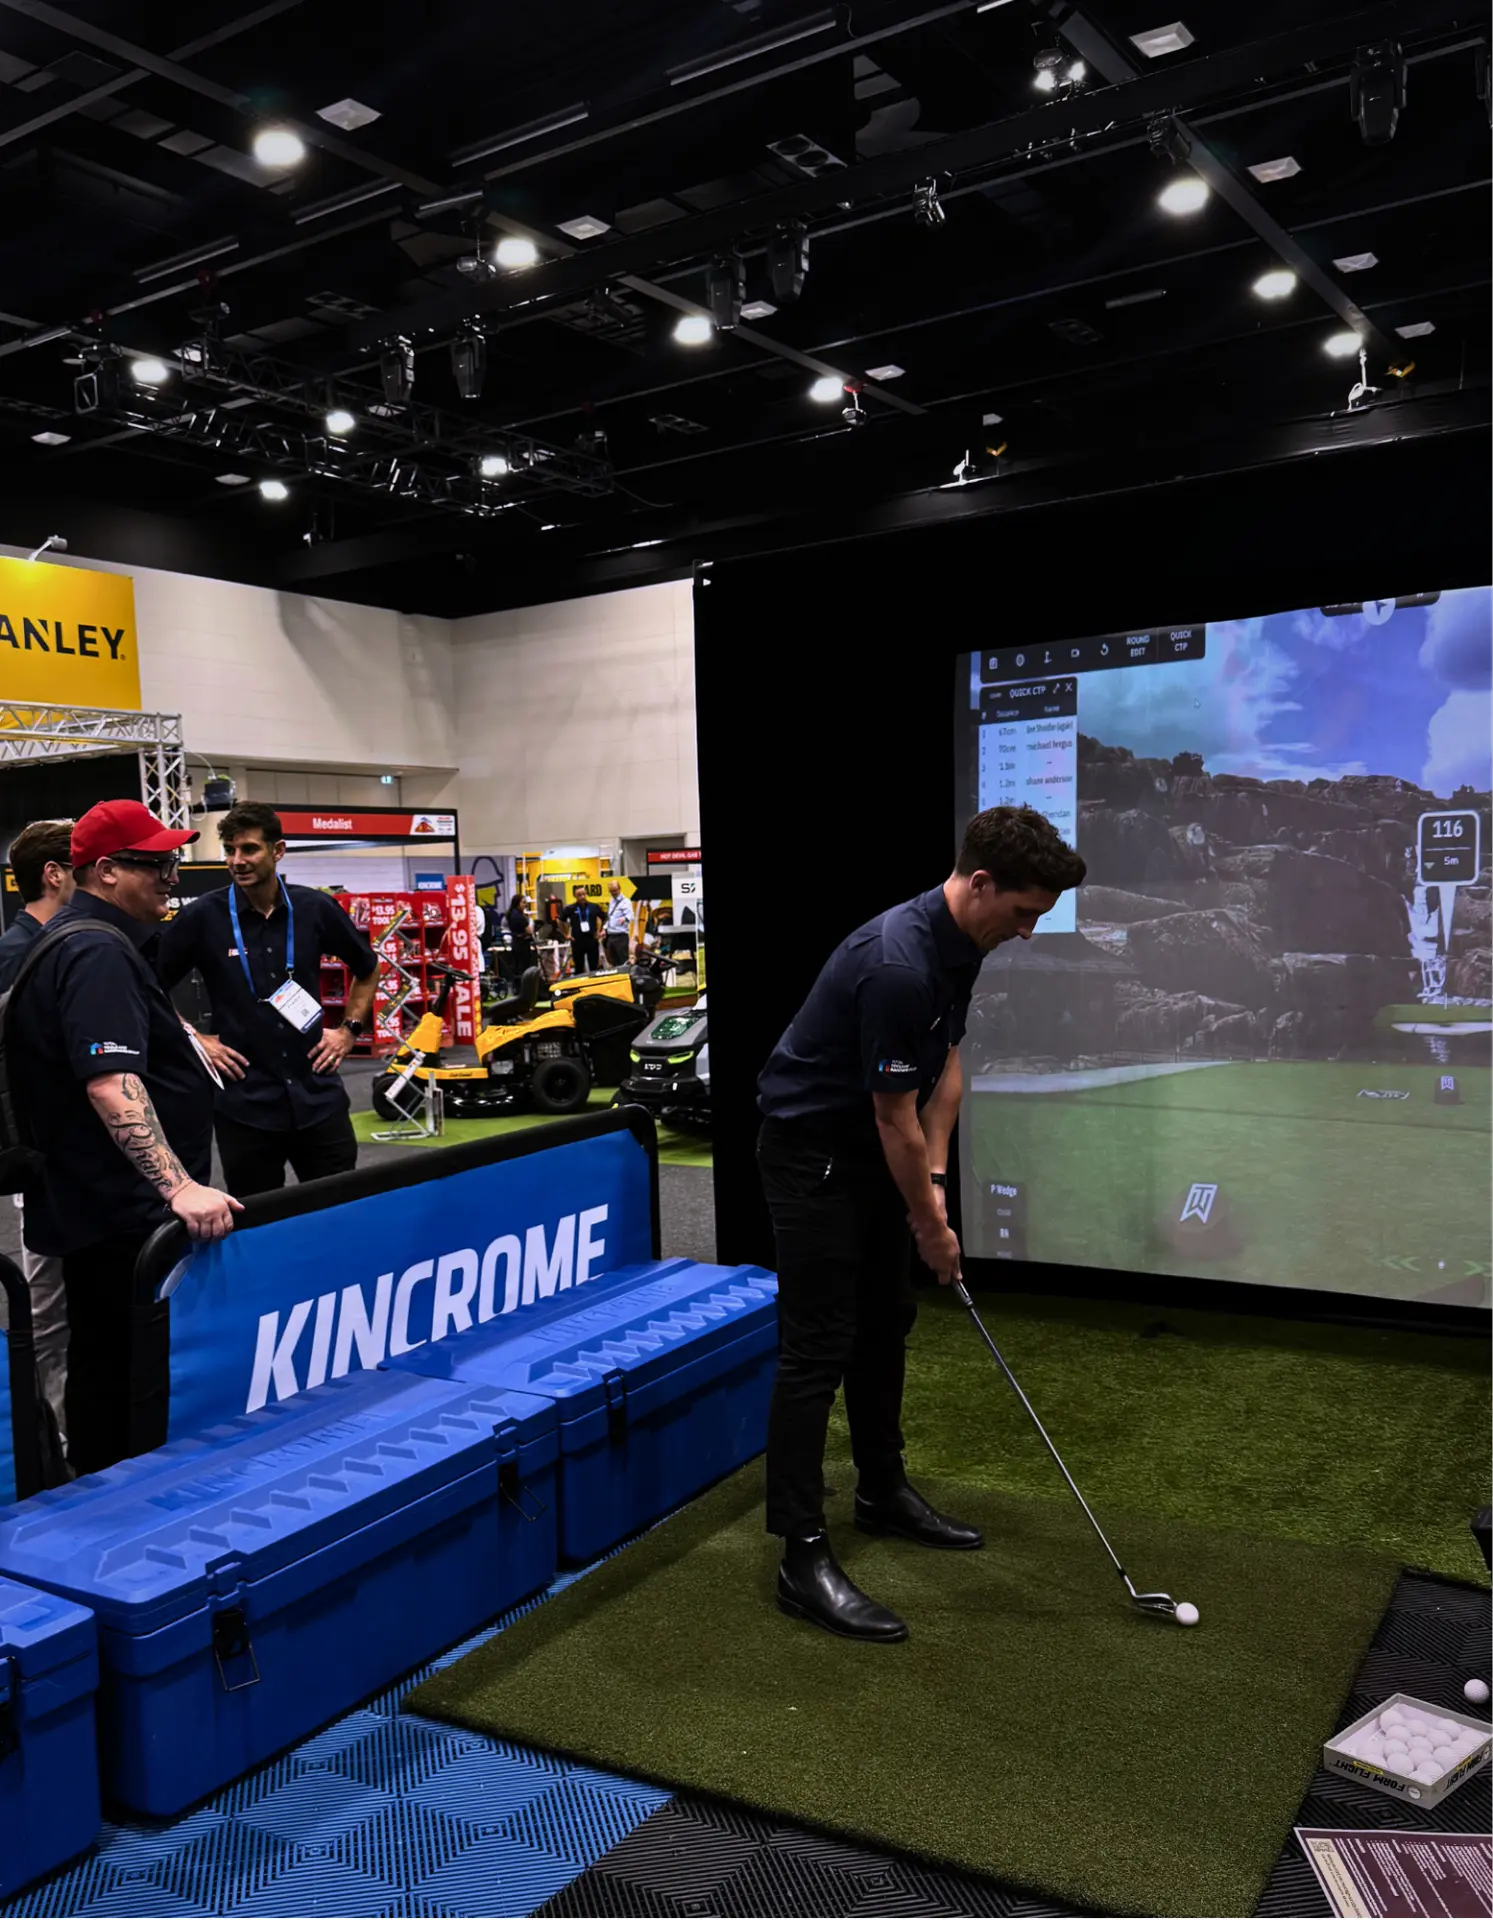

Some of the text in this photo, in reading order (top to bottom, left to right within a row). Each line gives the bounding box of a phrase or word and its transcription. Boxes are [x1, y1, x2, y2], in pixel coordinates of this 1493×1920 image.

[0, 613, 125, 660] ANLEY
[1126, 634, 1150, 646] ROUND
[1170, 629, 1192, 642] QUICK
[1130, 647, 1146, 657] EDIT
[1174, 642, 1188, 652] CTP
[1009, 687, 1031, 699] QUICK
[1032, 685, 1047, 695] CTP
[312, 817, 353, 830] Medalist
[1432, 819, 1463, 838] 116
[1443, 856, 1459, 866] 5m
[573, 884, 602, 897] ARD
[451, 884, 469, 960] $13.95
[246, 1203, 609, 1414] KINCROME
[1334, 1758, 1370, 1779] FLIGHT
[1373, 1772, 1406, 1792] FORM
